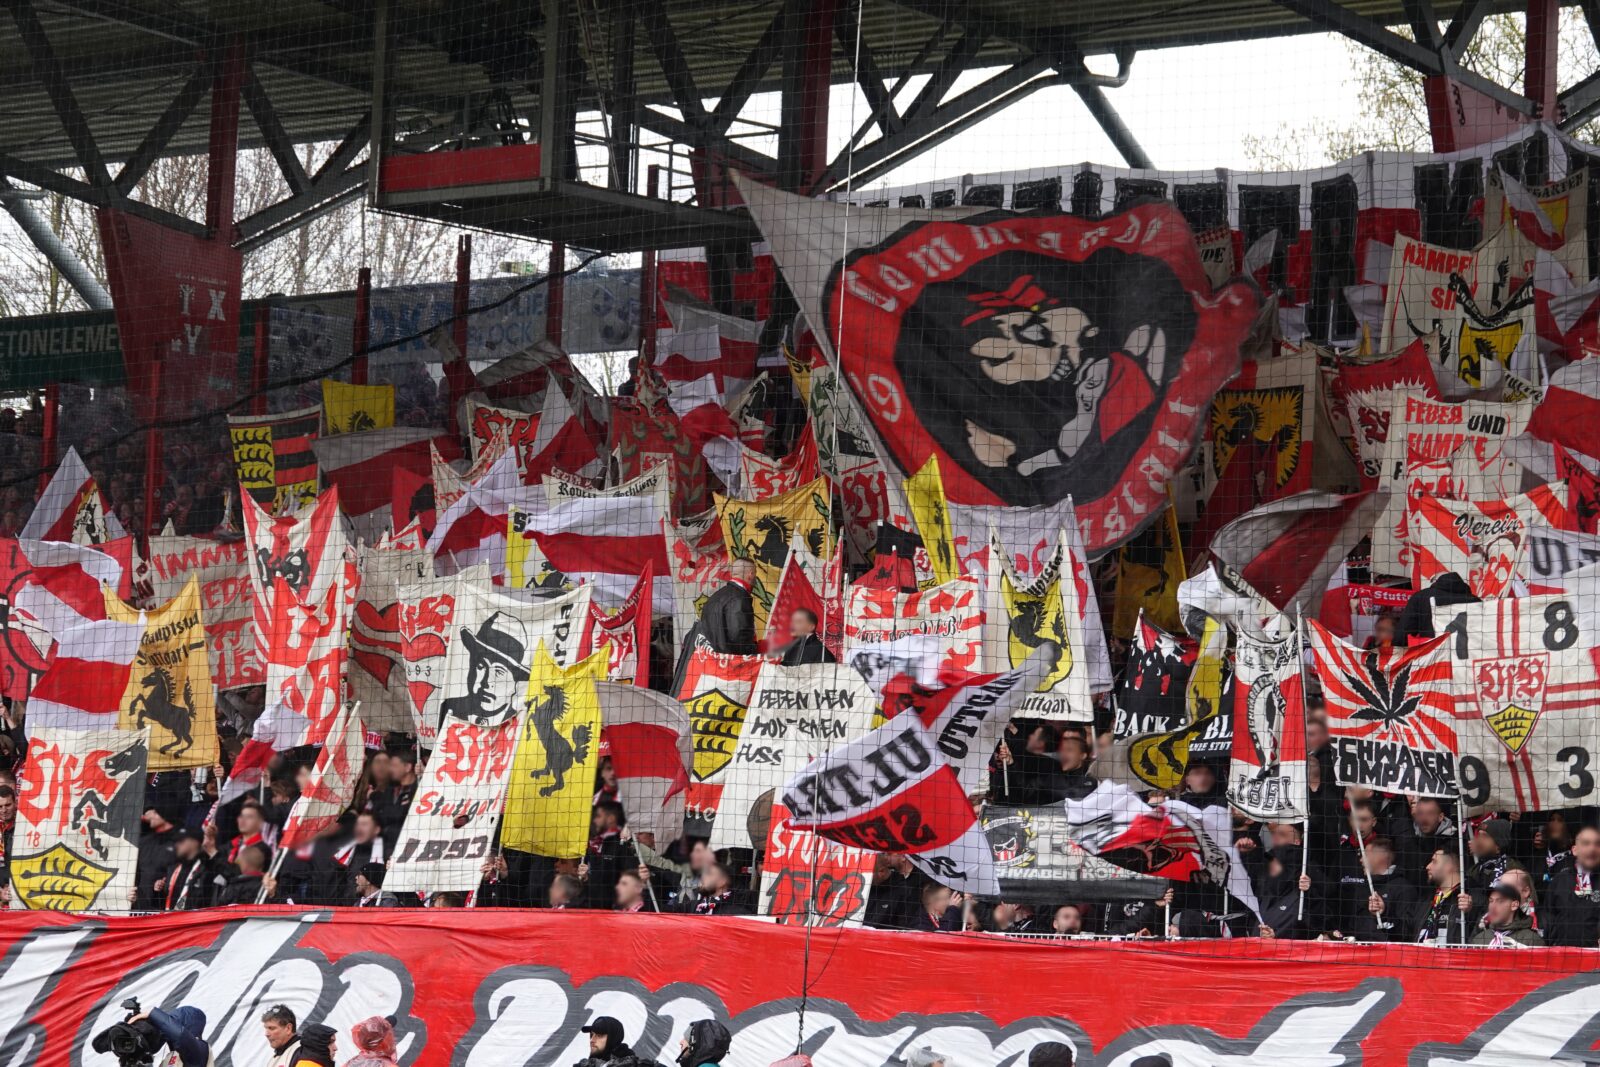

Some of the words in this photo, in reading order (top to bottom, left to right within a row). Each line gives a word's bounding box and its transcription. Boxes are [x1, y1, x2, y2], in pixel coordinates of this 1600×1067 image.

[1405, 396, 1463, 424] FEUER
[1467, 414, 1505, 435] UND
[1454, 513, 1519, 538] Verein
[1114, 708, 1168, 738] BACK
[396, 835, 488, 863] 1893
